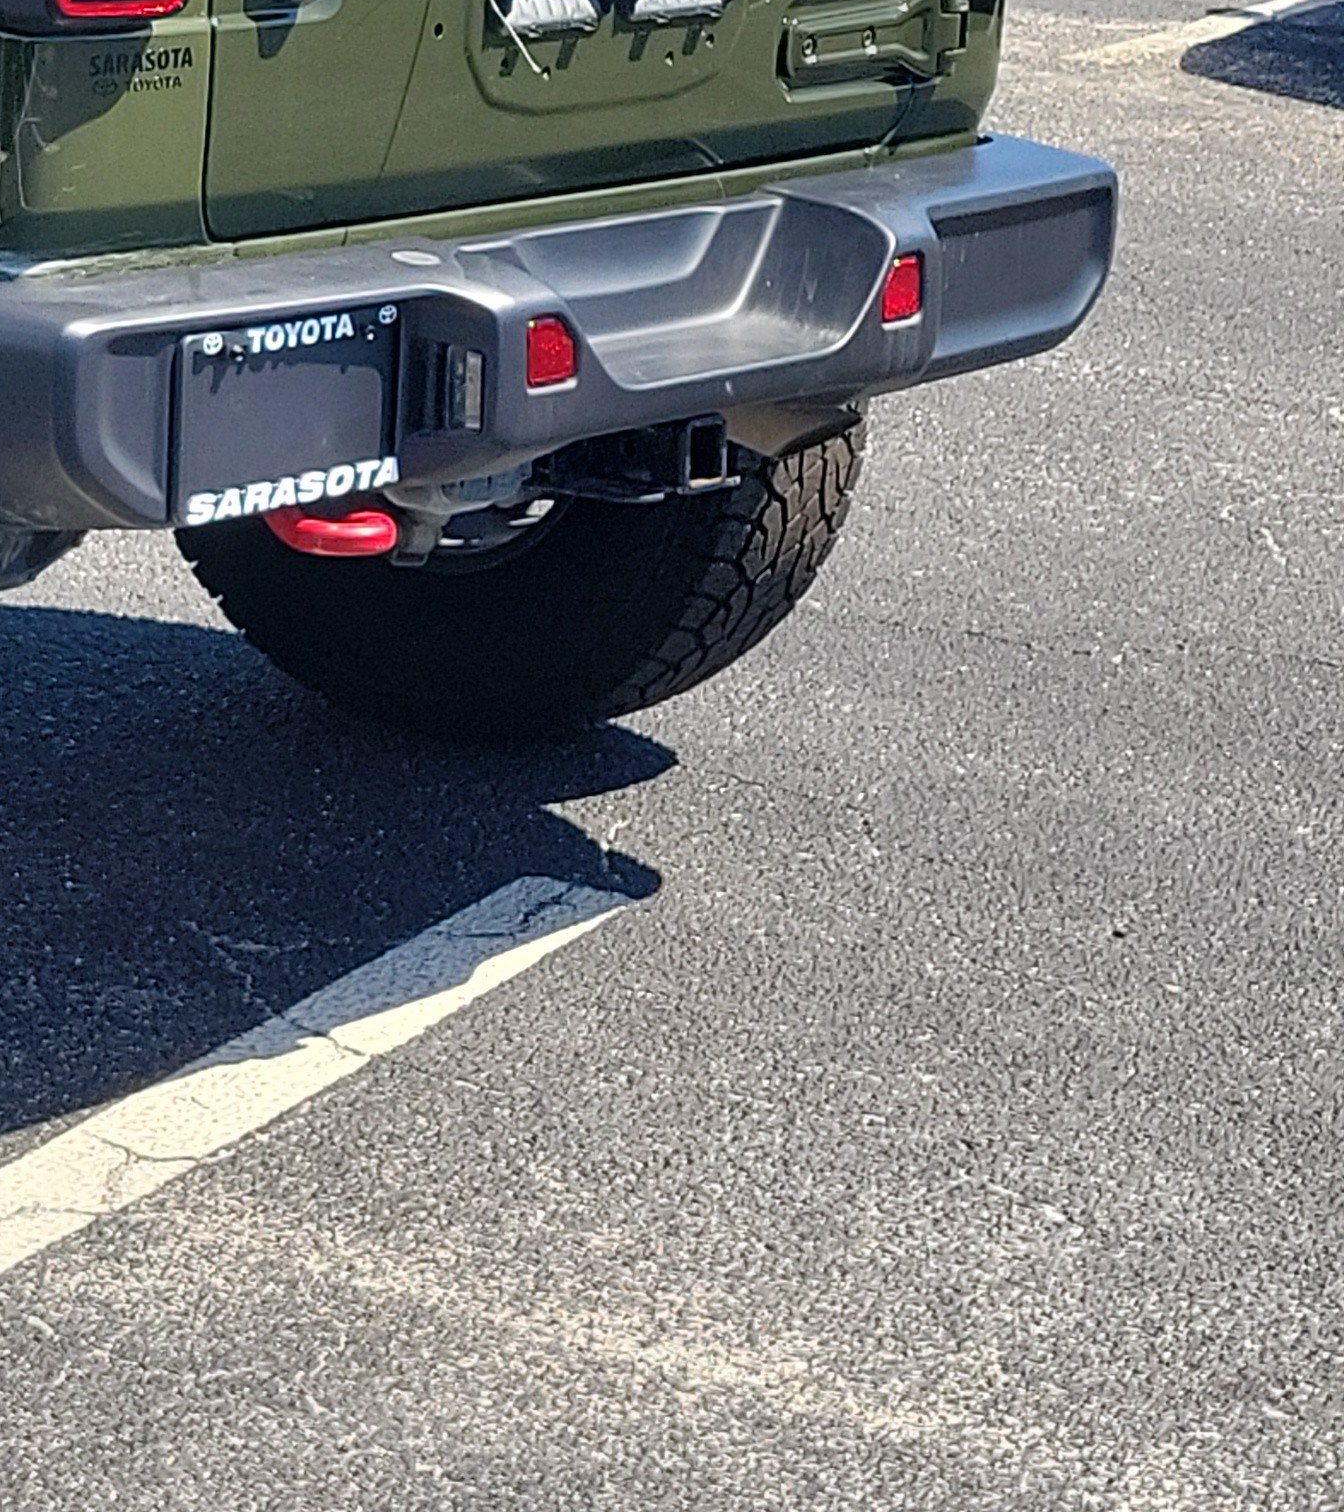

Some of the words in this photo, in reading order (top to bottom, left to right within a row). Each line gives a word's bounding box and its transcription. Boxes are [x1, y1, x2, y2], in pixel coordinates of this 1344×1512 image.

[88, 47, 194, 77] SARASOTA
[125, 76, 182, 93] TOYOTA
[247, 313, 355, 354] TOYOTA
[186, 456, 400, 527] SARASOTA
